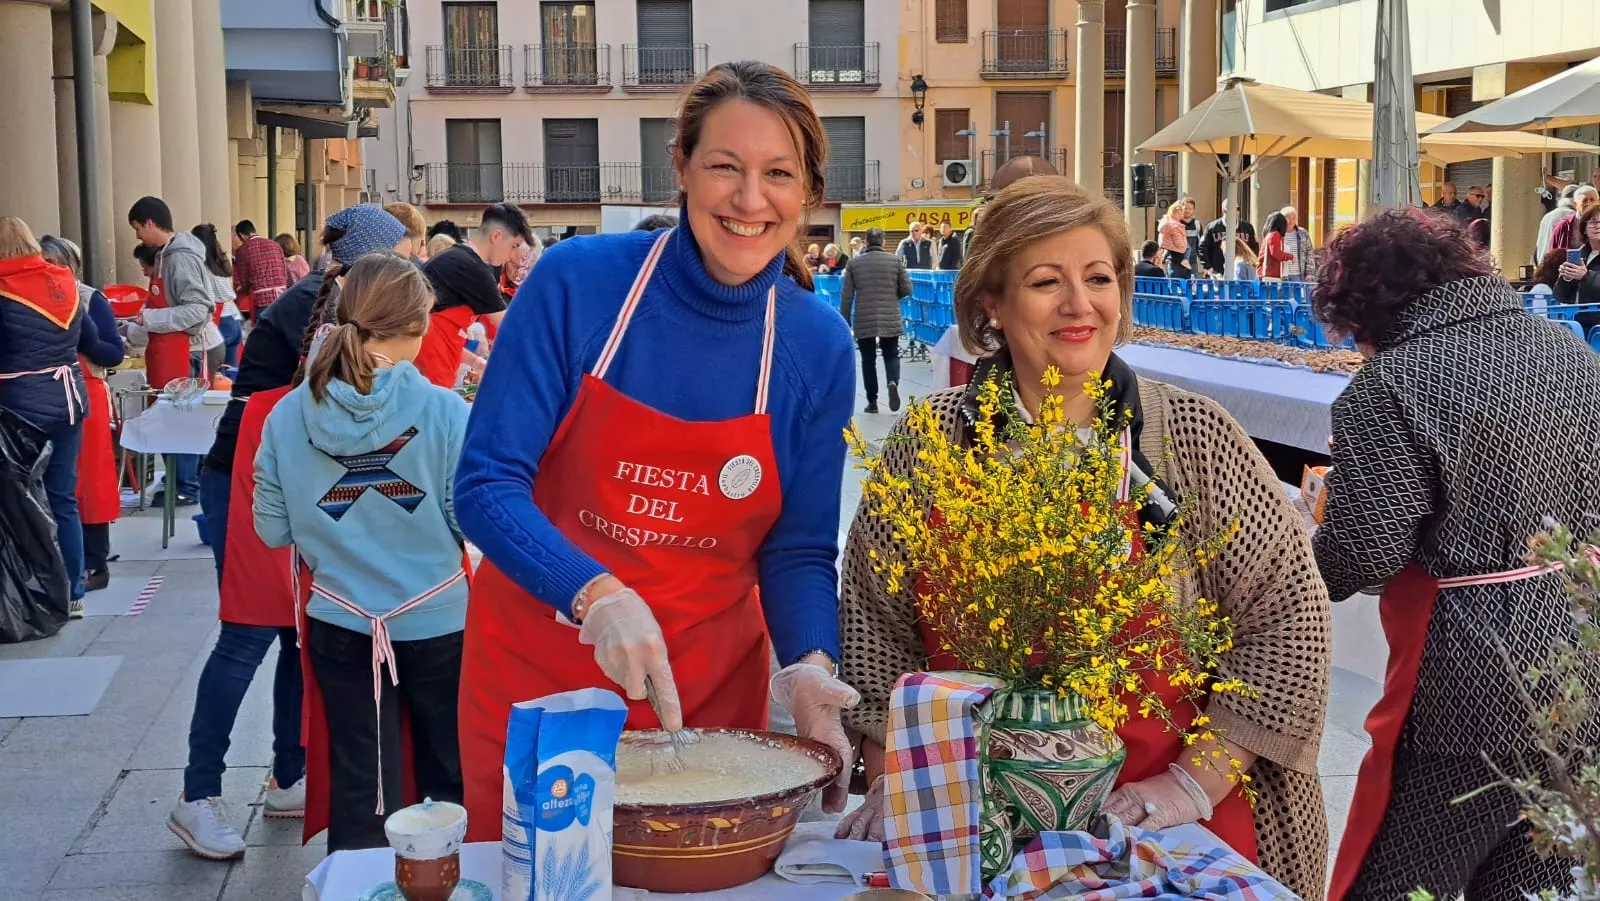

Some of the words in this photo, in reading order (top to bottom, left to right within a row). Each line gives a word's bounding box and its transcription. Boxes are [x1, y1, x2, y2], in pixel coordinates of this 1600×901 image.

[905, 212, 951, 226] CASA
[957, 211, 973, 225] P
[613, 460, 711, 496] FIESTA
[626, 493, 684, 523] DEL
[578, 509, 717, 549] CRESPILLO
